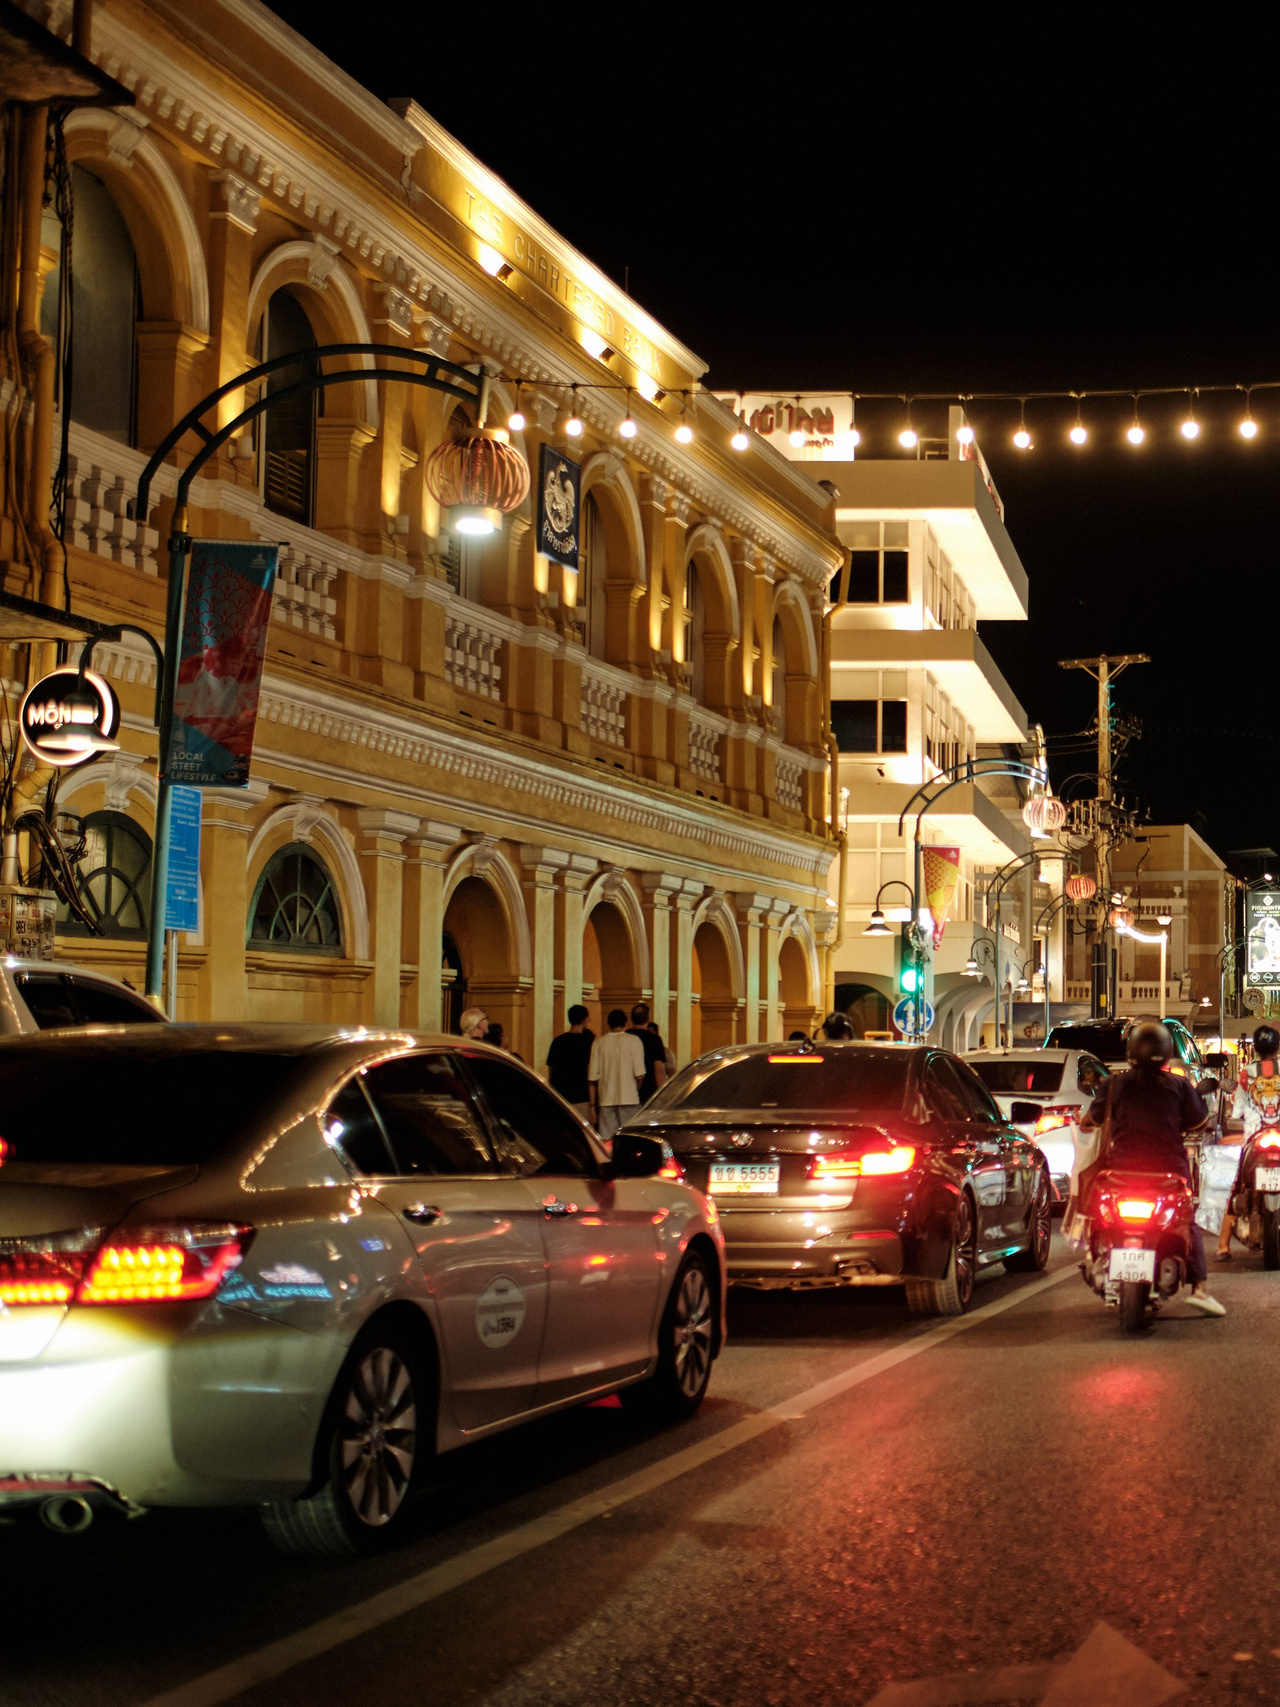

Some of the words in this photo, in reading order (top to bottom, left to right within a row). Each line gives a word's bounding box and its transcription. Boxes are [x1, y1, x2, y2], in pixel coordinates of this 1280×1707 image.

[465, 188, 503, 246] THE
[514, 233, 616, 337] CHARTERED
[623, 325, 662, 378] BANK
[172, 751, 205, 762] LOCAL
[171, 761, 202, 771] STEET
[171, 771, 217, 782] LIFESTYLE
[741, 1166, 776, 1181] 5555
[1116, 1271, 1147, 1281] 4306
